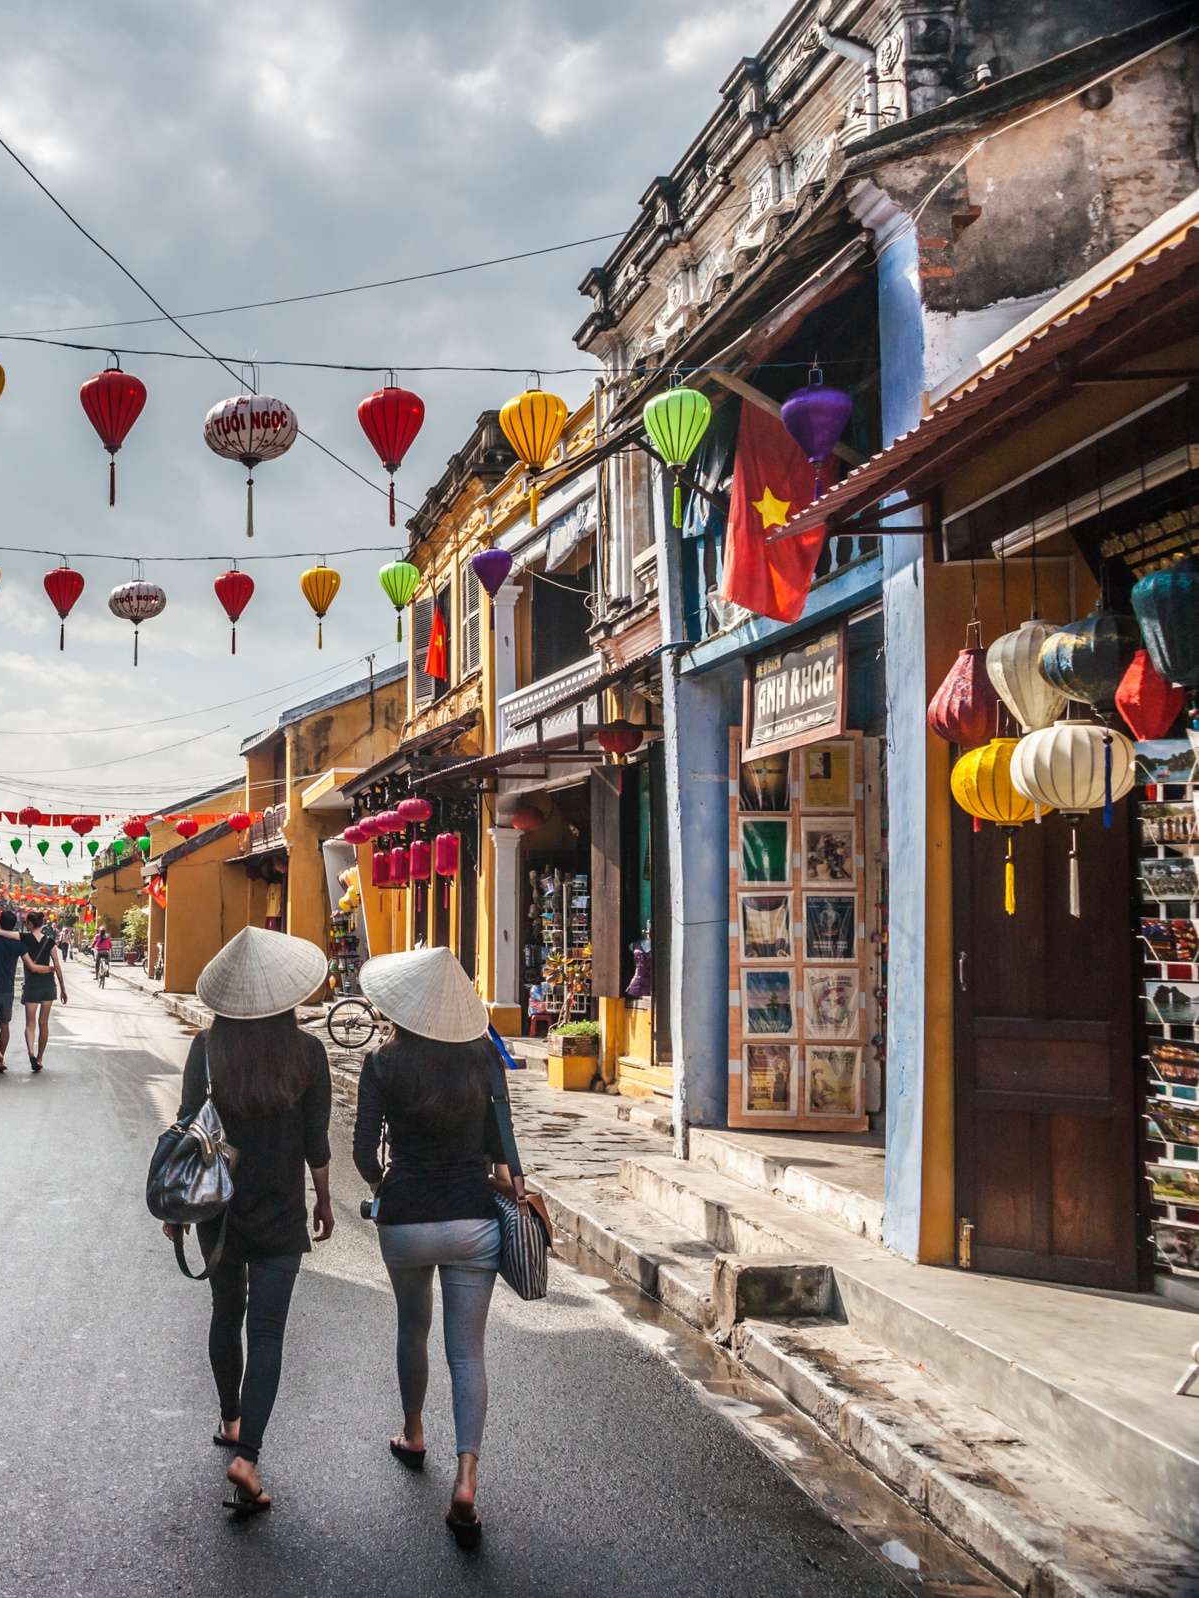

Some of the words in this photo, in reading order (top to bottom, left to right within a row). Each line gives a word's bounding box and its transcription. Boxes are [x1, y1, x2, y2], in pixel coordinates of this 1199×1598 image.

[214, 407, 246, 436] TUỔI
[250, 410, 288, 433] NGỌC
[757, 674, 787, 719] ANH
[790, 656, 834, 705] KHOA
